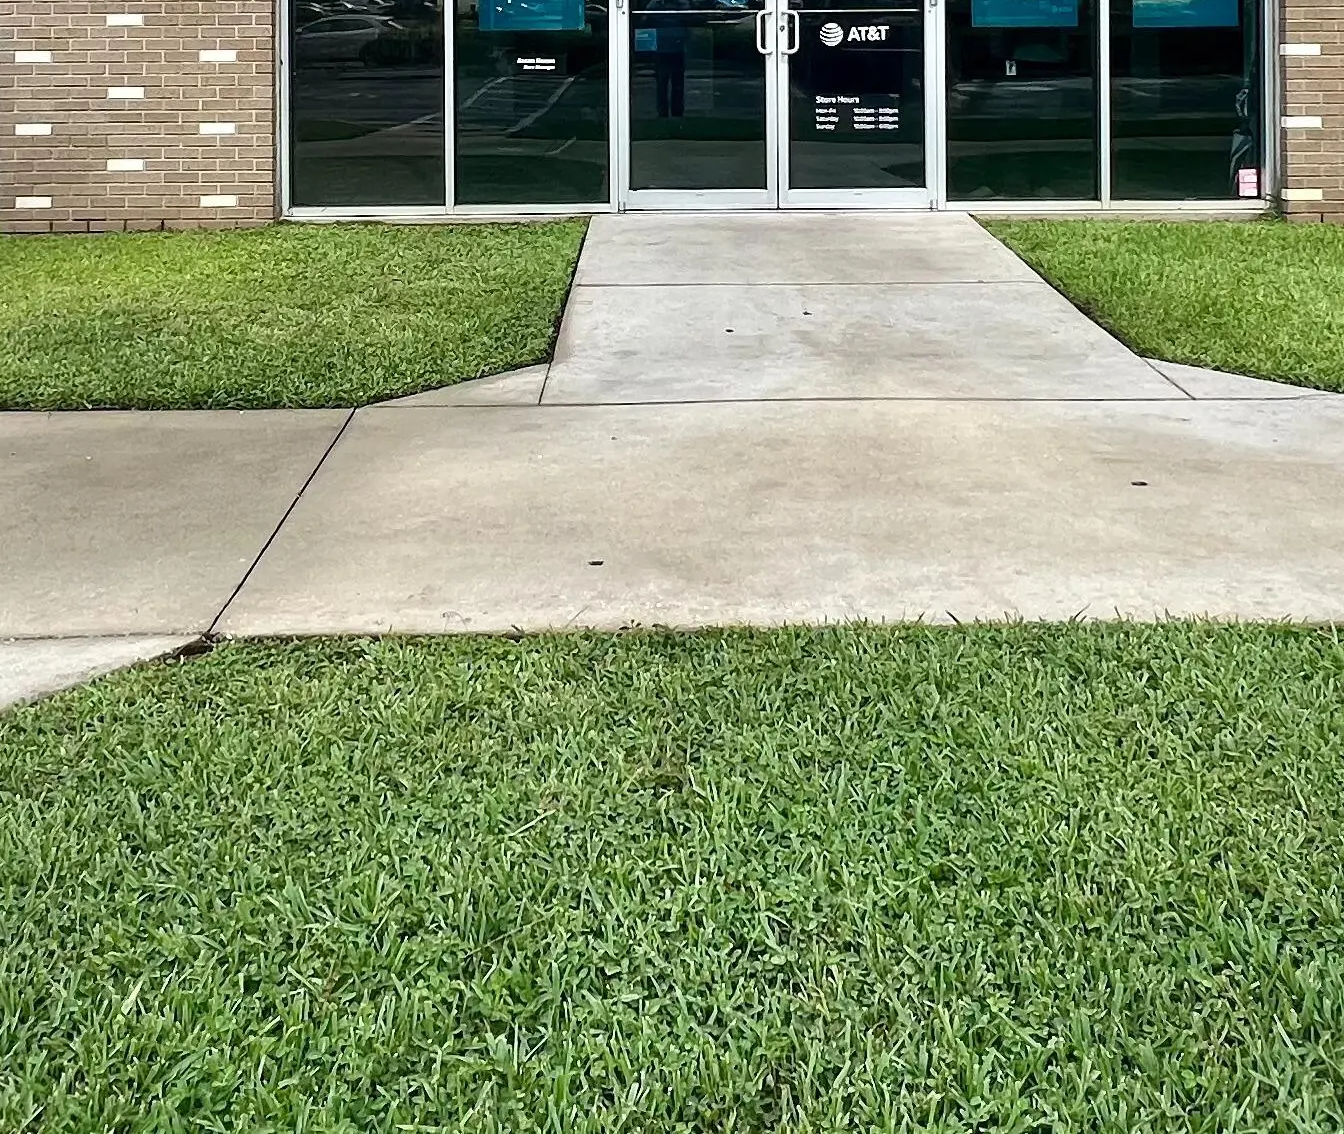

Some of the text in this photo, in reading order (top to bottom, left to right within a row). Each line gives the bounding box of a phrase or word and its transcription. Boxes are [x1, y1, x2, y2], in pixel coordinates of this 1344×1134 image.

[847, 25, 890, 42] AT&T
[815, 95, 860, 104] Store Hours
